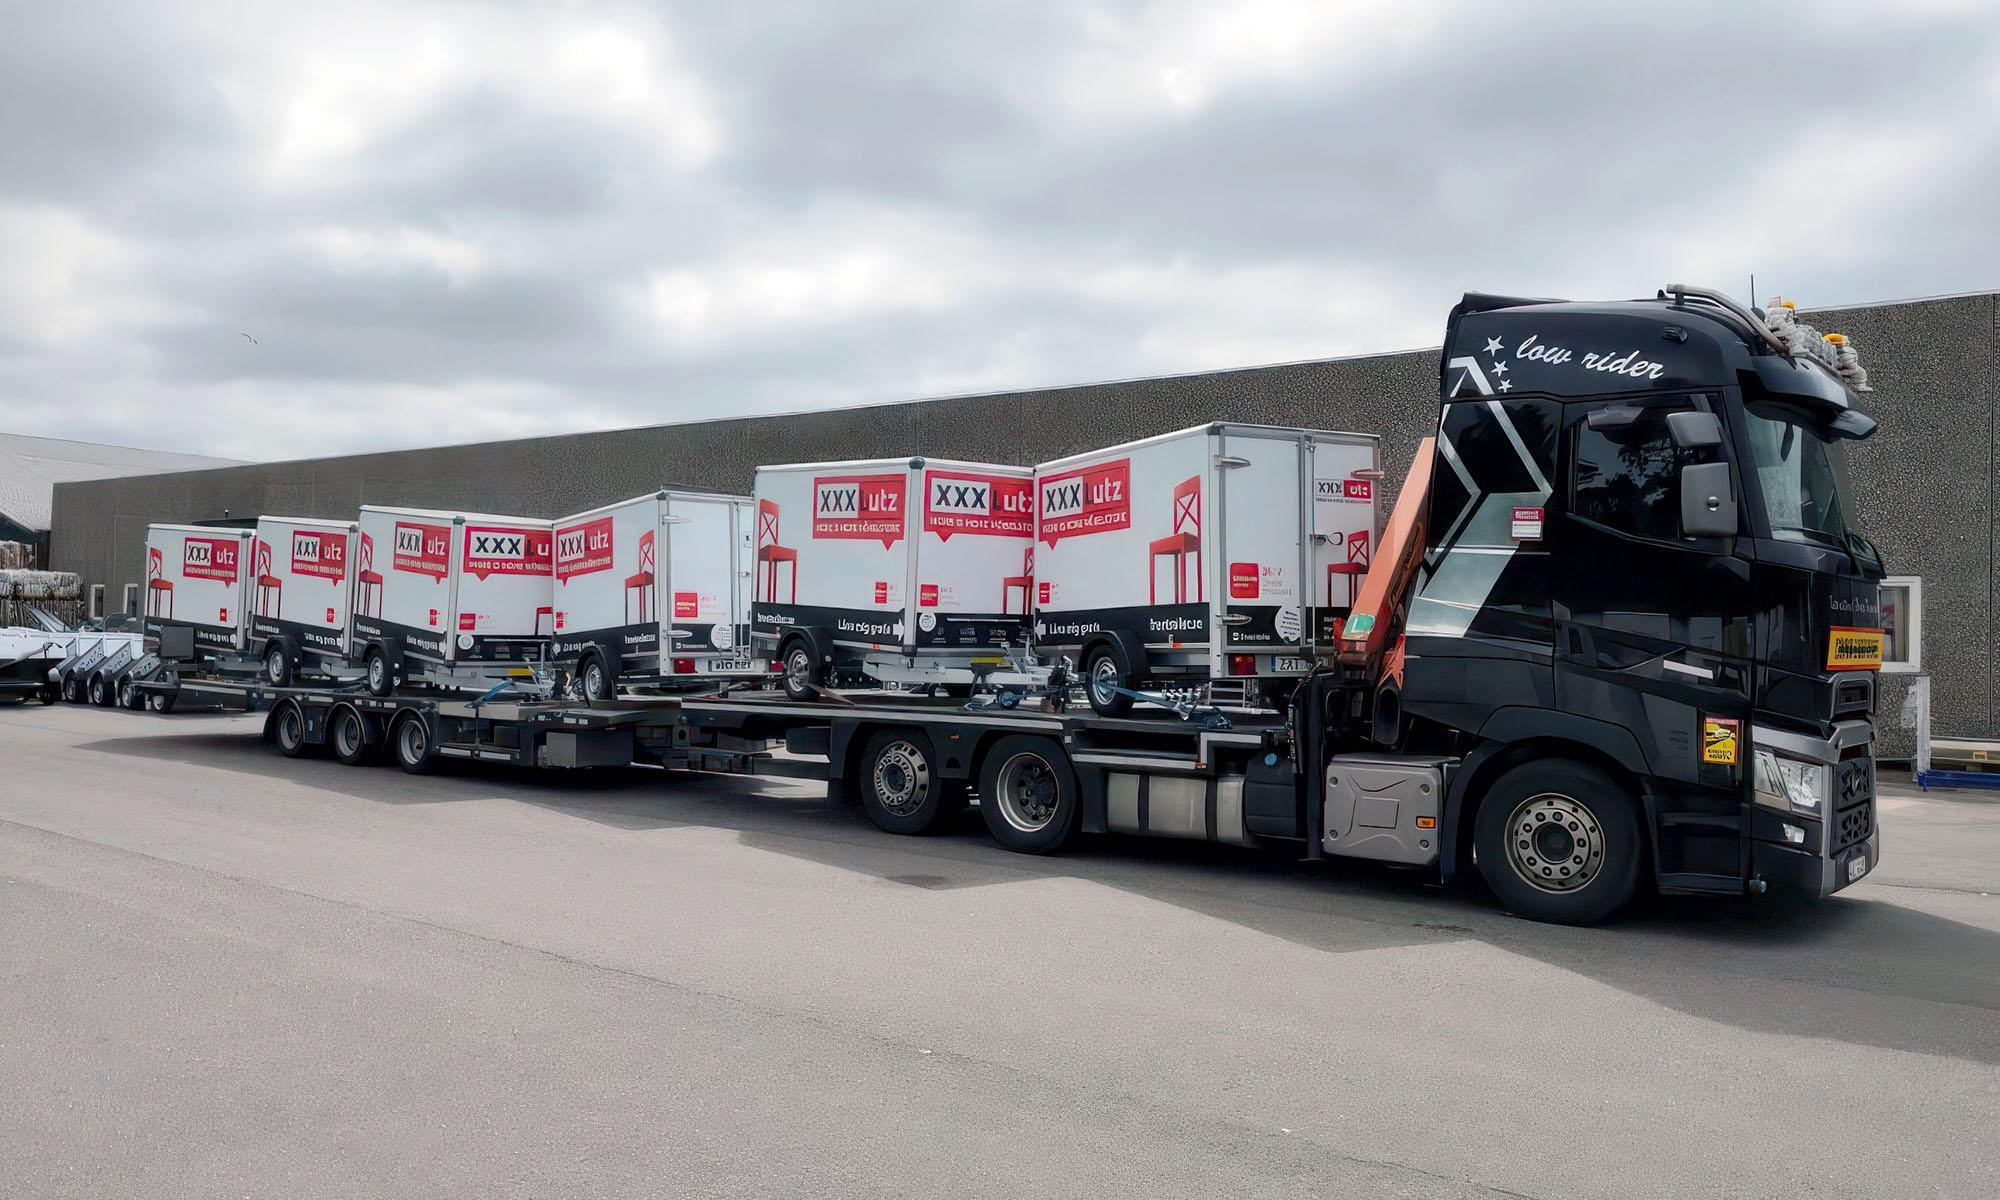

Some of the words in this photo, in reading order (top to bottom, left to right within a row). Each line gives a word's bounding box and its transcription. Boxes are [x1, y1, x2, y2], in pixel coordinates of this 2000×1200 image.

[1515, 334, 1572, 365] low
[1581, 350, 1664, 379] rider
[475, 536, 549, 556] XXXLu
